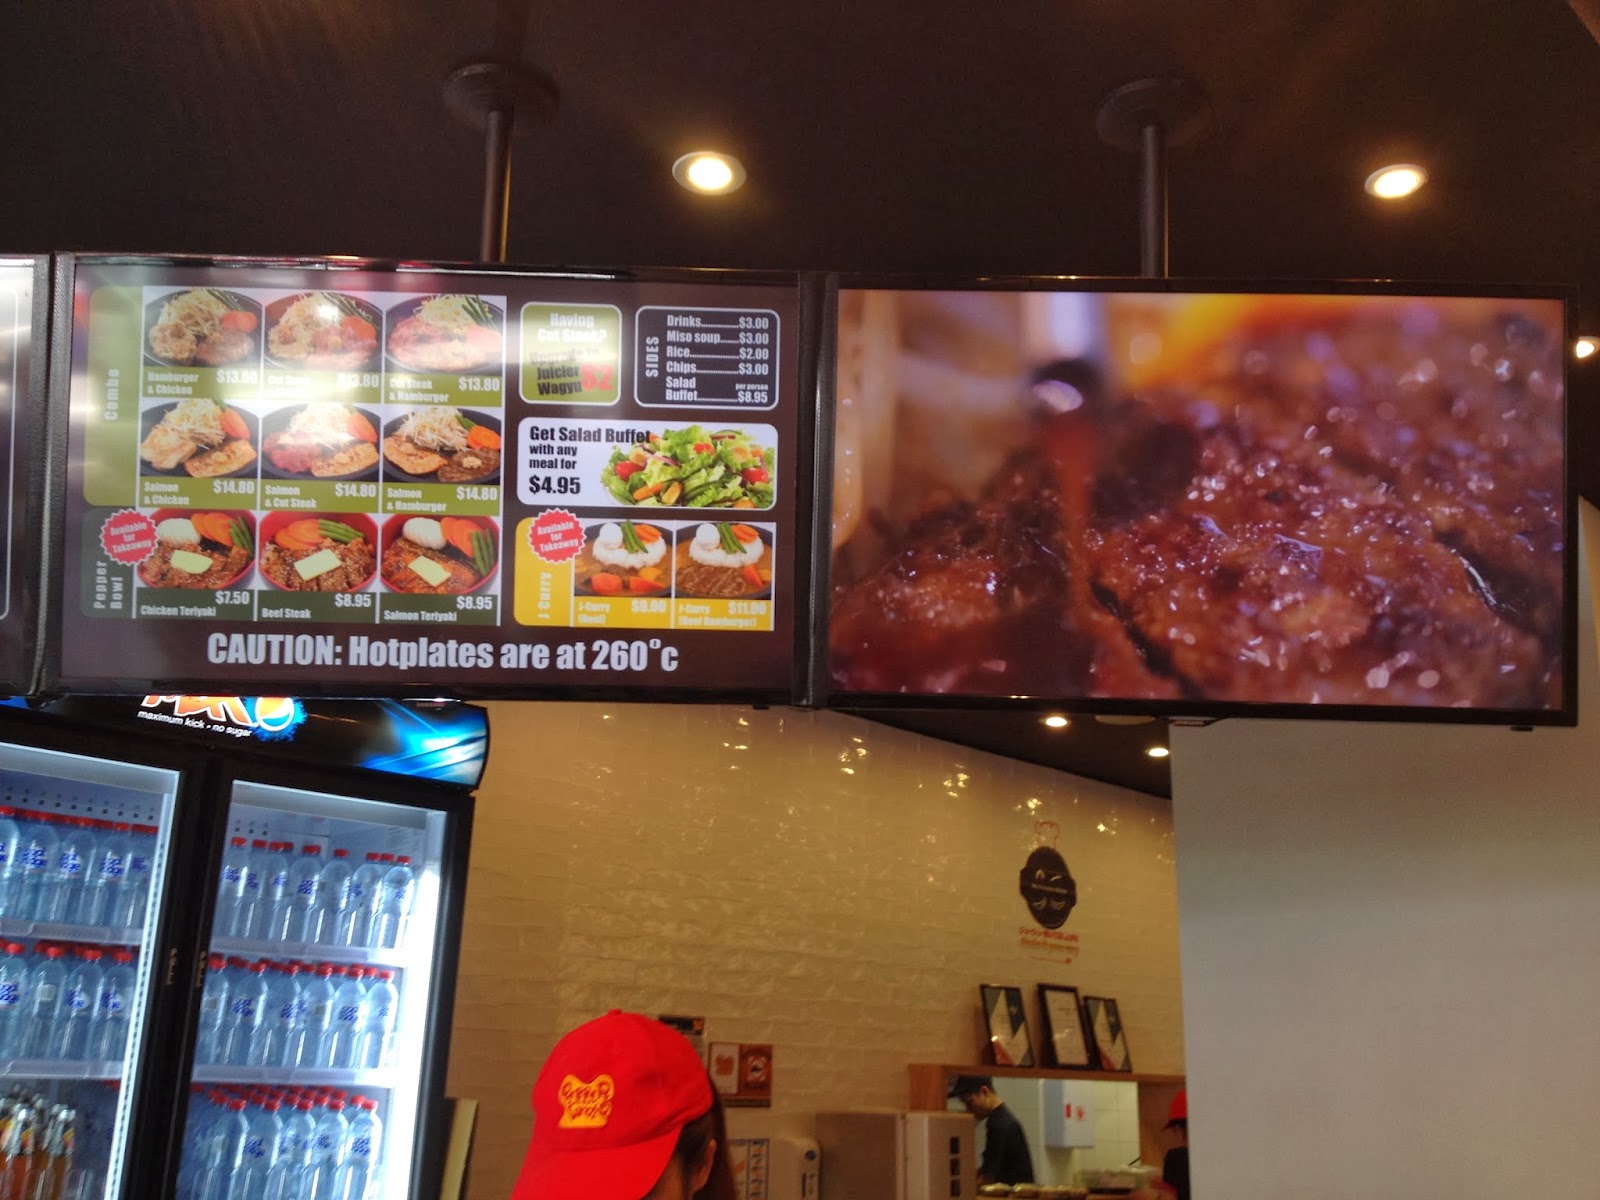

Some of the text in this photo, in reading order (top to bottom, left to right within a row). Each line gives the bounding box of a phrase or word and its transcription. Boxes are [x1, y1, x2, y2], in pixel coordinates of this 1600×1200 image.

[550, 312, 594, 328] Having
[667, 315, 769, 329] Drinks $3.00
[667, 330, 769, 345] Miso soup $3.00
[645, 336, 659, 378] SIDES
[666, 345, 769, 360] Rice $2.00
[537, 365, 579, 380] Juicier
[666, 361, 769, 376] Chips $3.00
[148, 371, 199, 383] Hamburger
[407, 379, 432, 390] Steak
[458, 376, 500, 391] $13.80
[666, 376, 696, 389] Salad
[156, 384, 193, 395] Chicken
[537, 381, 582, 396] Wagyu
[666, 389, 768, 403] Buffet $8.95
[397, 391, 449, 402] Hamburger
[530, 426, 651, 443] Get Salad Buffet
[529, 444, 577, 456] with any
[529, 458, 577, 469] meal for
[144, 480, 255, 494] Salmon $14.80
[264, 482, 377, 498] Salmon $14.80
[529, 475, 581, 495] $4.95
[144, 495, 190, 505] & Chicken
[387, 485, 498, 501] Salmon $14.80
[264, 498, 317, 509] & Cut Steak
[387, 501, 447, 512] & Hamburger
[110, 521, 148, 536] Available
[537, 521, 574, 535] Available
[123, 533, 136, 542] for
[550, 533, 562, 541] for
[112, 539, 152, 554] Takeaway
[540, 538, 579, 552] Takeaway
[94, 561, 108, 609] Pepper
[110, 577, 123, 609] Bowl
[215, 590, 250, 605] $7.50
[334, 593, 372, 608] $8.95
[456, 595, 493, 610] $8.95
[140, 605, 216, 617] Chicken Teriyaki
[261, 607, 311, 619] Beef Steak
[384, 610, 457, 622] Salmon Teriyaki
[207, 632, 342, 666] CAUTION:
[348, 636, 494, 670] Hotplates
[500, 643, 550, 669] are
[556, 640, 585, 670] at
[137, 710, 252, 738] maximum kick no sugar
